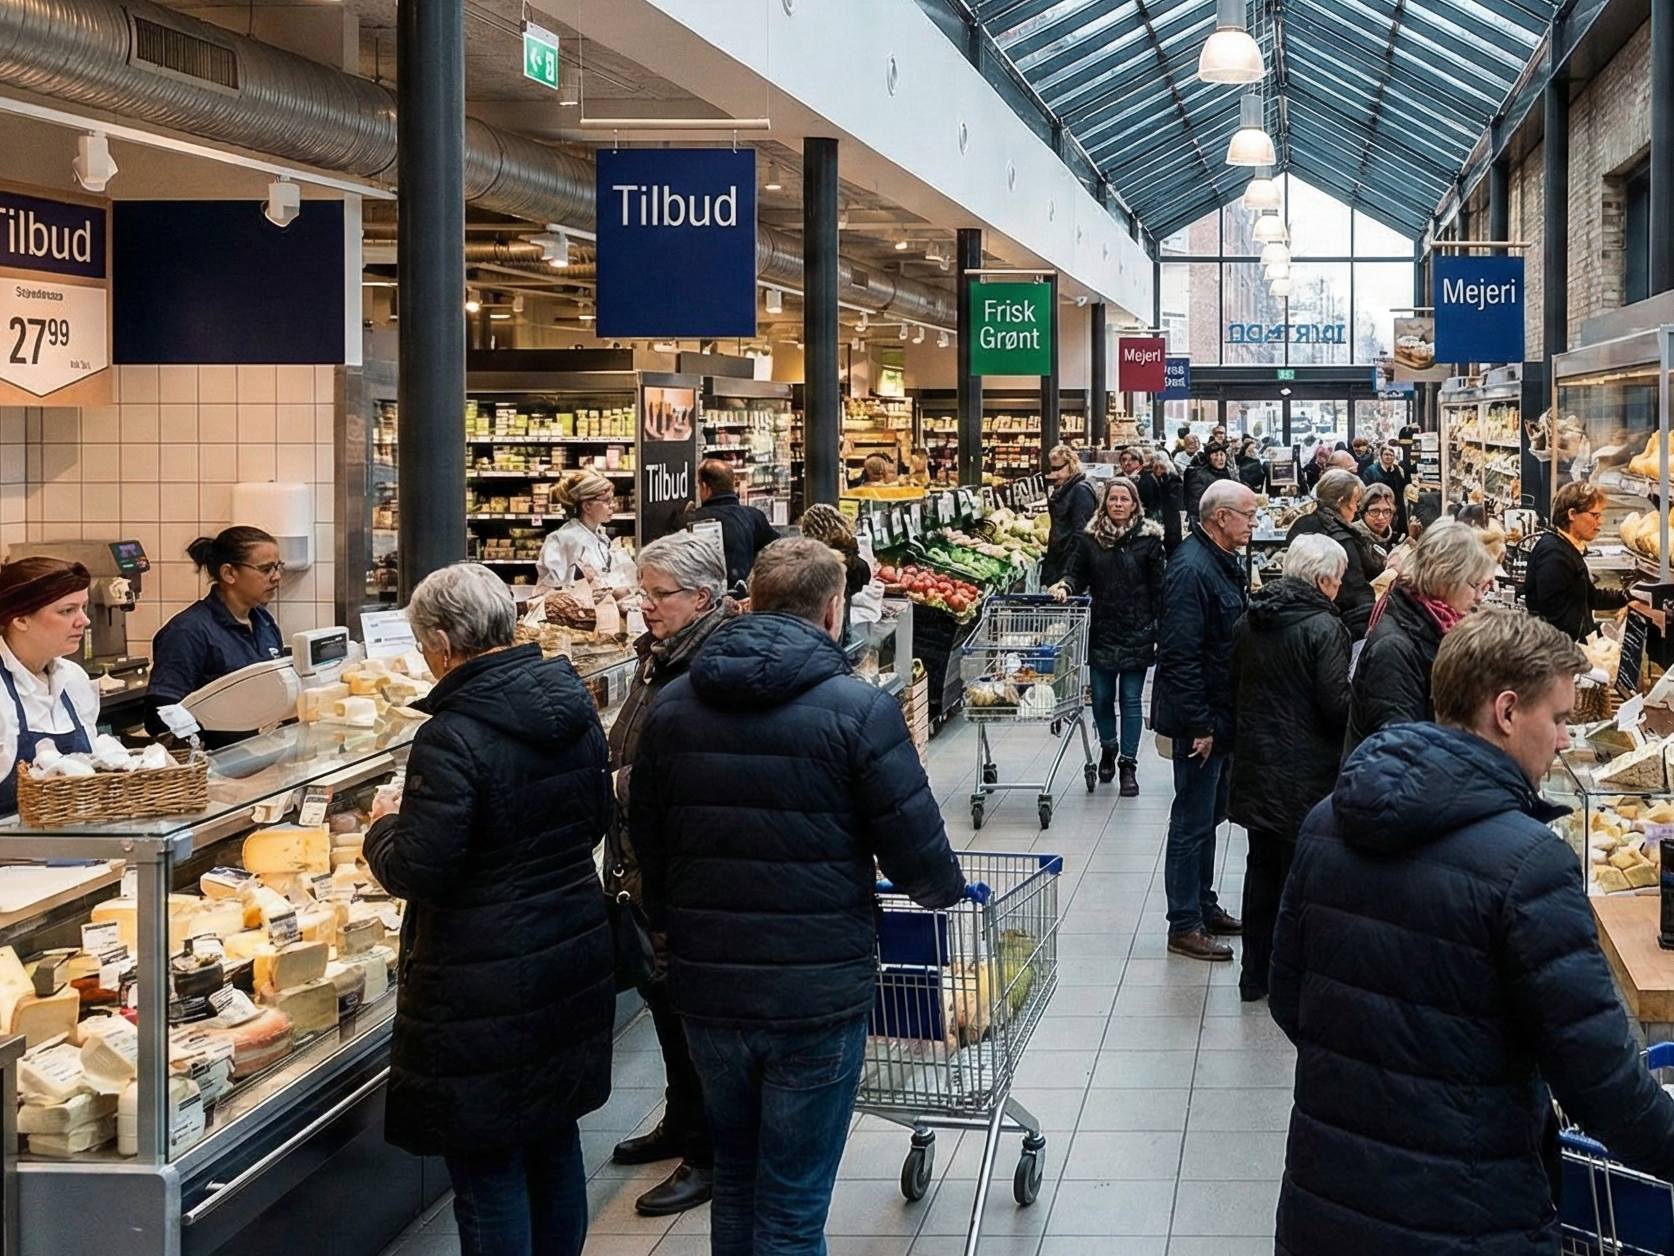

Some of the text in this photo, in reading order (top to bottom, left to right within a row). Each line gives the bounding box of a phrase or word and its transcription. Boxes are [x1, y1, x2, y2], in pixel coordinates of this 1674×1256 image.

[612, 184, 737, 227] Tilbud
[1443, 278, 1516, 310] Mejeri
[984, 299, 1037, 323] Frisk
[980, 326, 1041, 350] Grønt
[645, 461, 689, 502] Tilbud
